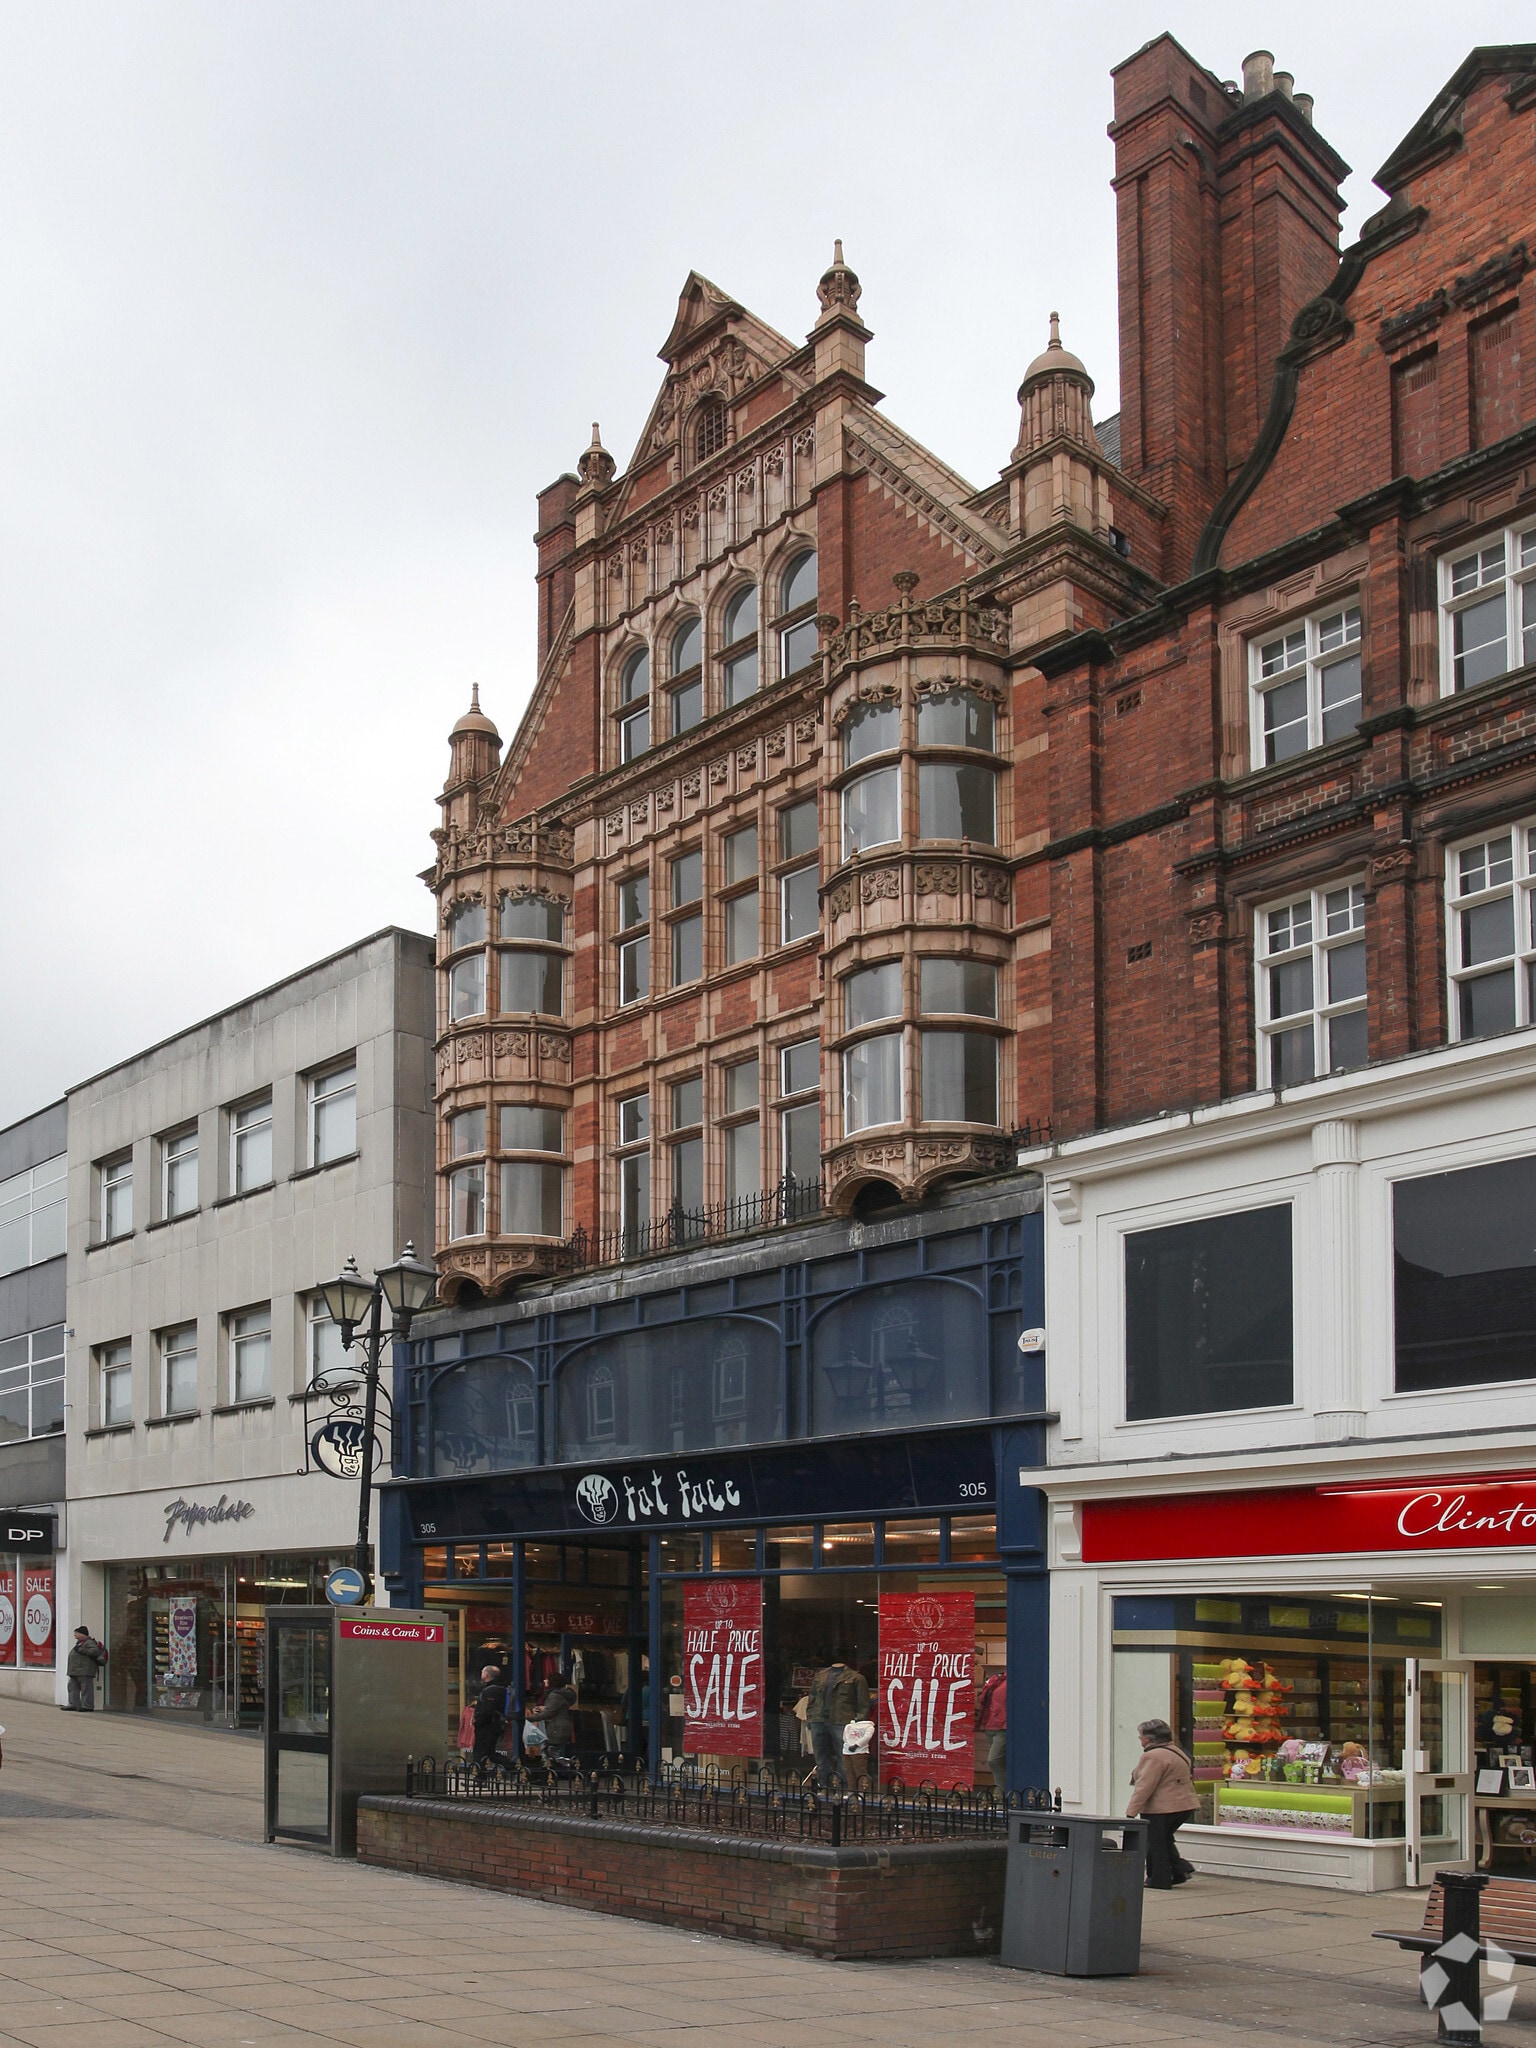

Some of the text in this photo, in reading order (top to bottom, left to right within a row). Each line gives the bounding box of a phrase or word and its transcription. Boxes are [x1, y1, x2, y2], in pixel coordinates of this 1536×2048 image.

[622, 1469, 740, 1521] fat face
[959, 1482, 987, 1497] 305
[162, 1494, 256, 1543] Paperchase
[8, 1528, 44, 1541] DP
[420, 1522, 437, 1534] 305
[26, 1577, 51, 1592] SALE
[27, 1608, 50, 1626] 50%
[531, 1613, 556, 1625] £15
[568, 1615, 594, 1627] £15
[715, 1619, 733, 1630] UP TO
[352, 1625, 420, 1638] Coins & Cards
[686, 1630, 760, 1653] HALF PRICE
[917, 1642, 939, 1653] UP TO
[883, 1653, 972, 1678] HALF PRICE
[686, 1653, 760, 1720] SALE
[882, 1678, 972, 1751] SALE
[1028, 1848, 1058, 1860] Litter
